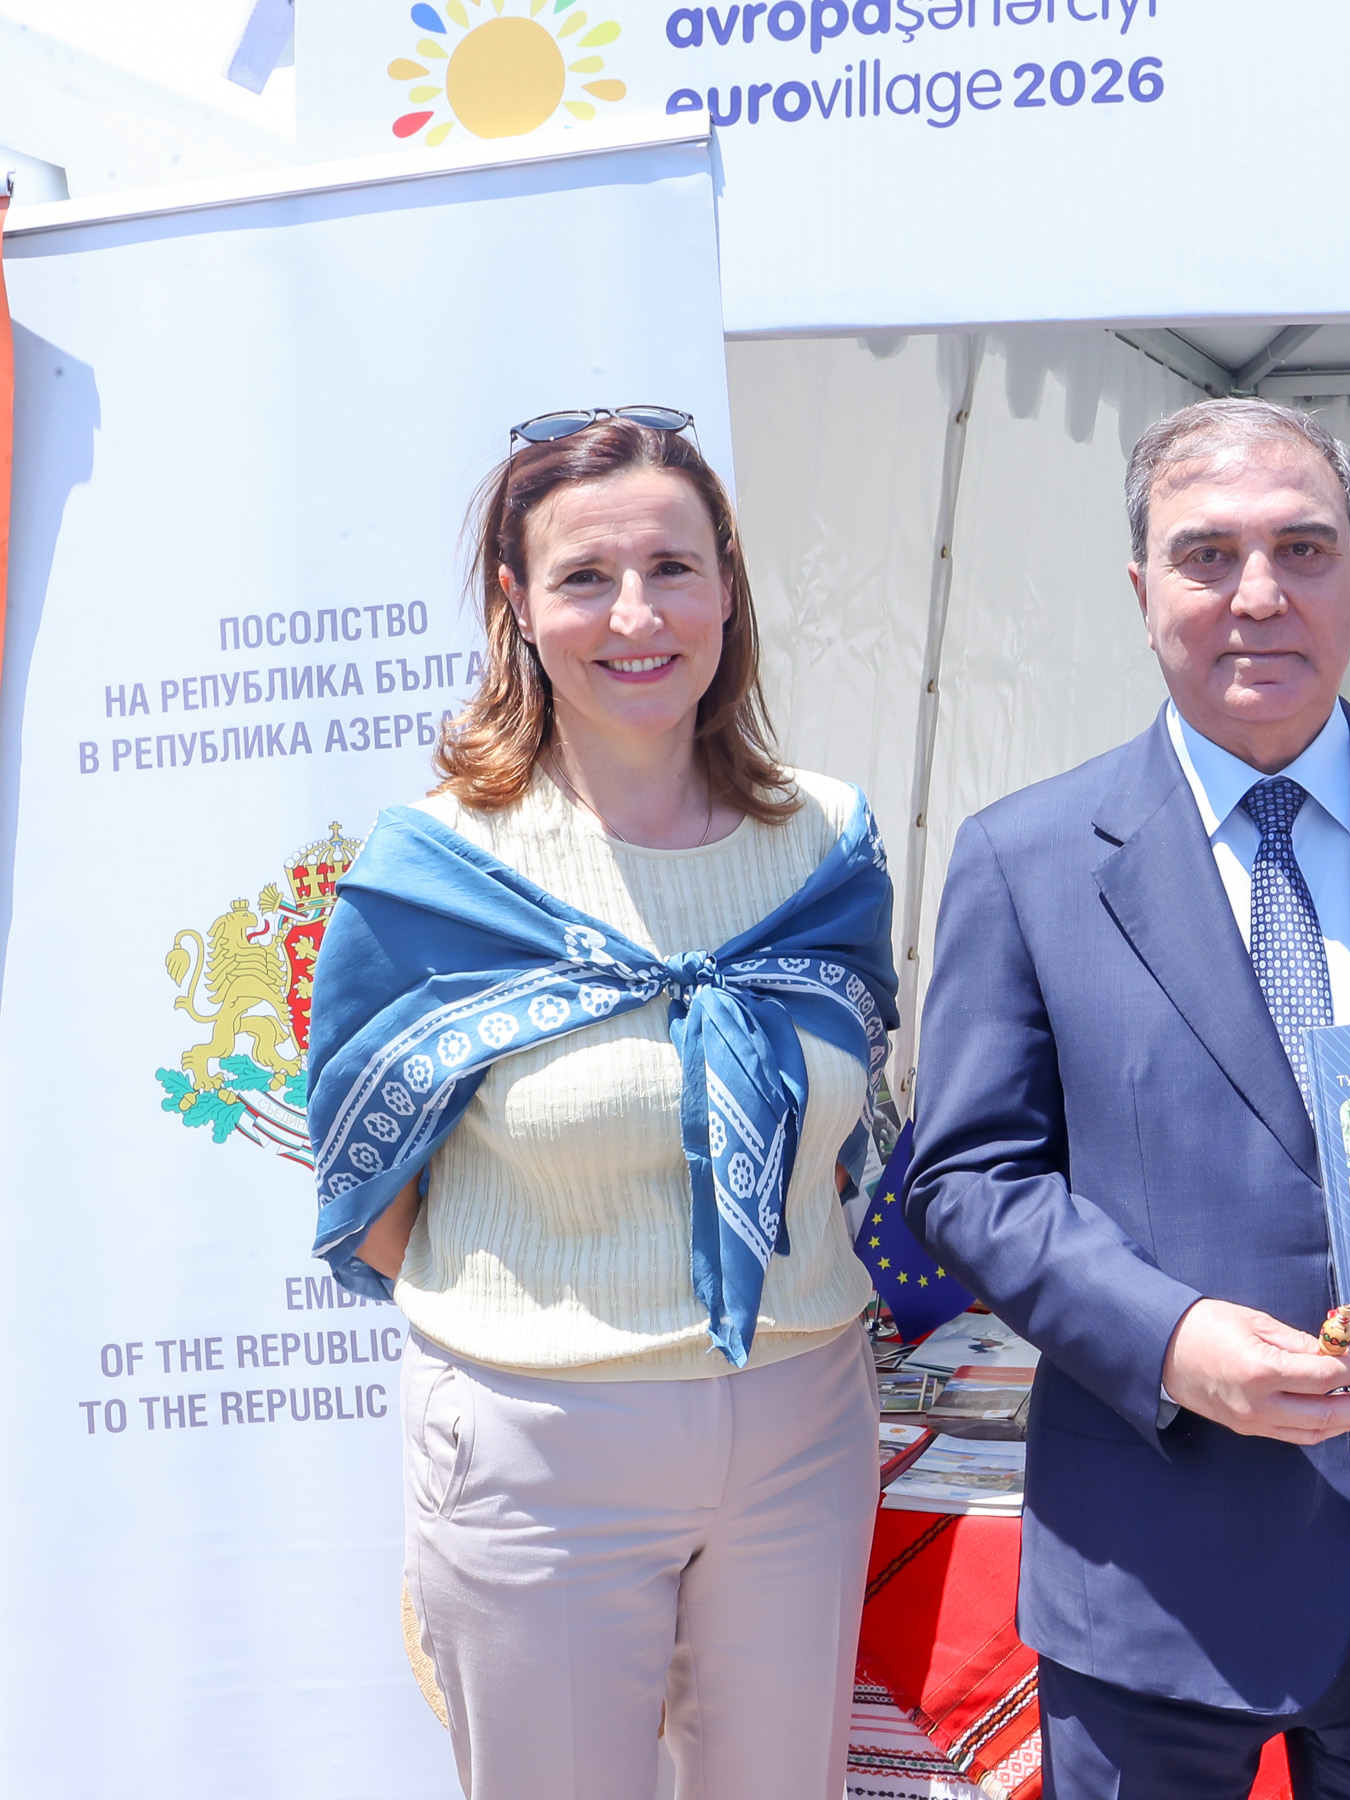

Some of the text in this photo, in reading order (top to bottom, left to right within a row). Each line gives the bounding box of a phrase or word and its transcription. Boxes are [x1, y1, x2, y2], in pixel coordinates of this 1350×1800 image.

[219, 600, 428, 651] ПОСОЛСТВО
[105, 650, 488, 718] НА РЕПУБЛИКА БЪЛГА
[79, 741, 99, 774] В
[112, 721, 313, 771] РЕПУБЛИКА
[257, 1098, 308, 1132] СЪЕДИН
[101, 1327, 402, 1377] OF THE REPUBLIC
[79, 1383, 388, 1435] TO THE REPUBLIC
